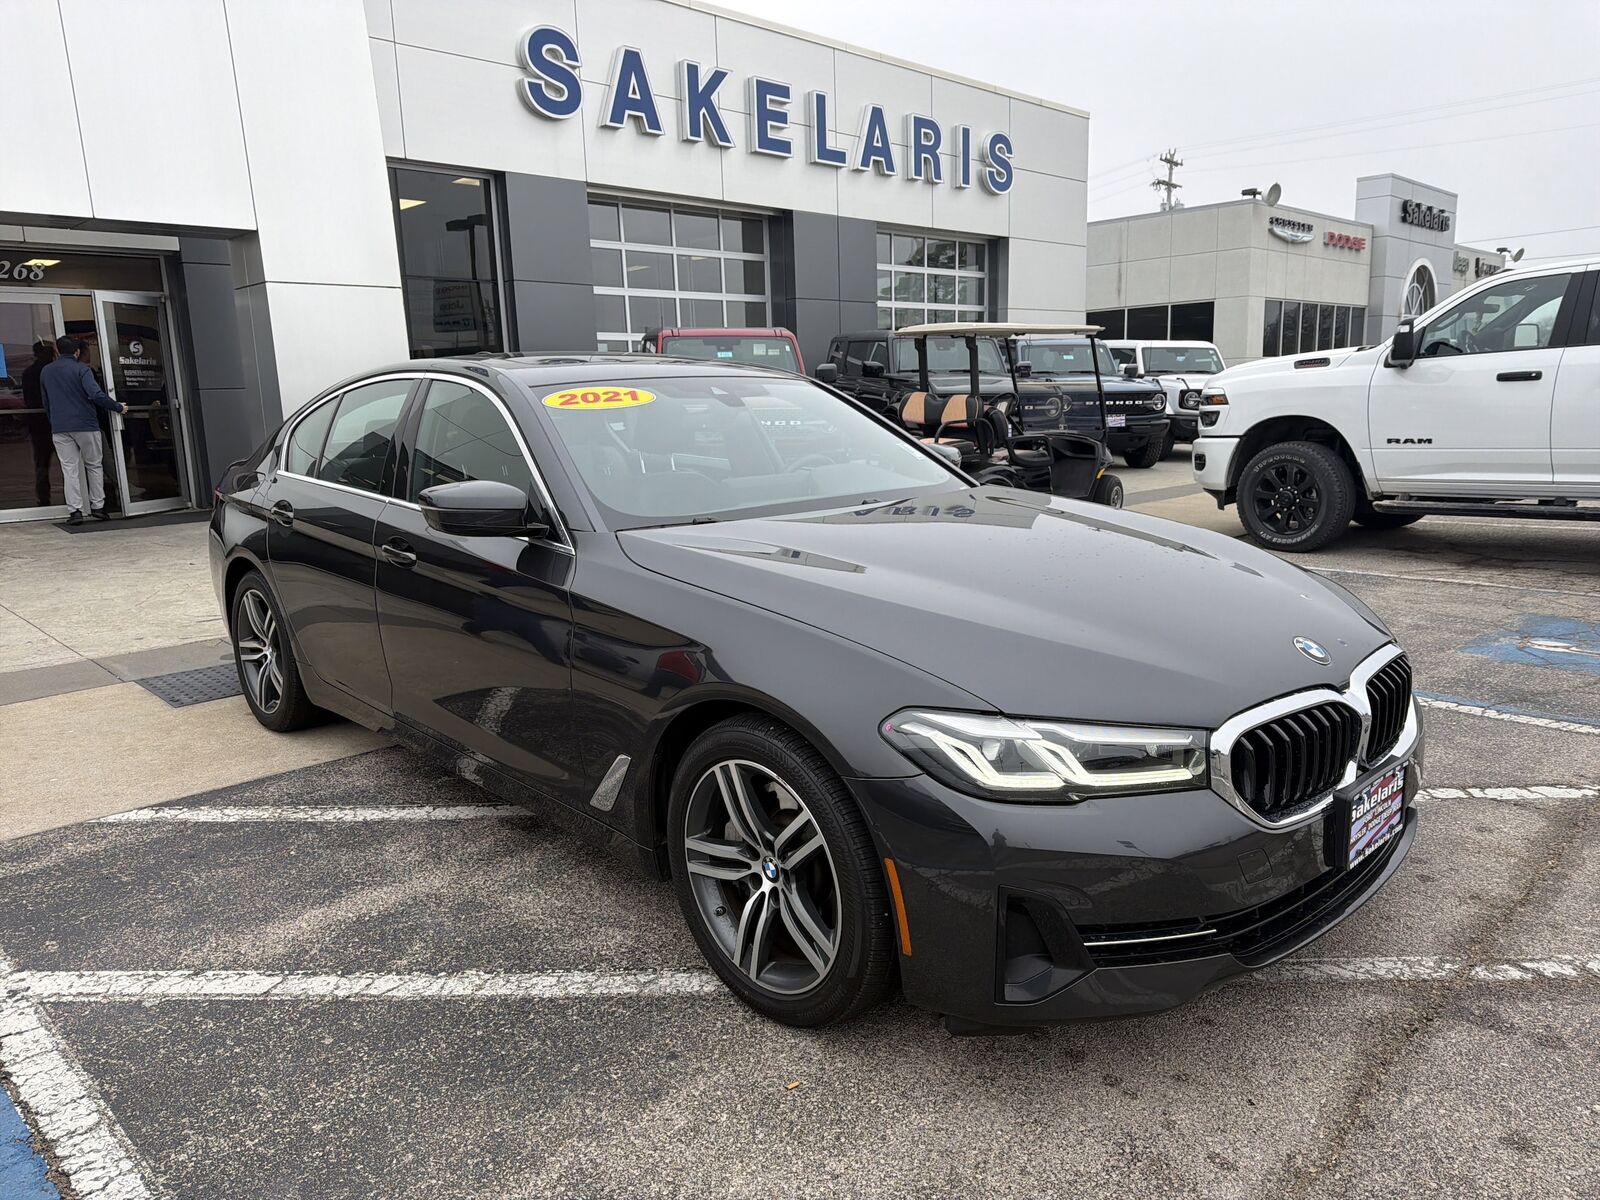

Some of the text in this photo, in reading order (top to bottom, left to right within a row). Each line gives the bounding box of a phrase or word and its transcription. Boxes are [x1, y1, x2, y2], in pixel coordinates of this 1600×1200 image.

[516, 24, 1014, 196] SAKELARIS
[1323, 231, 1366, 252] DODGE
[558, 390, 640, 407] 2021
